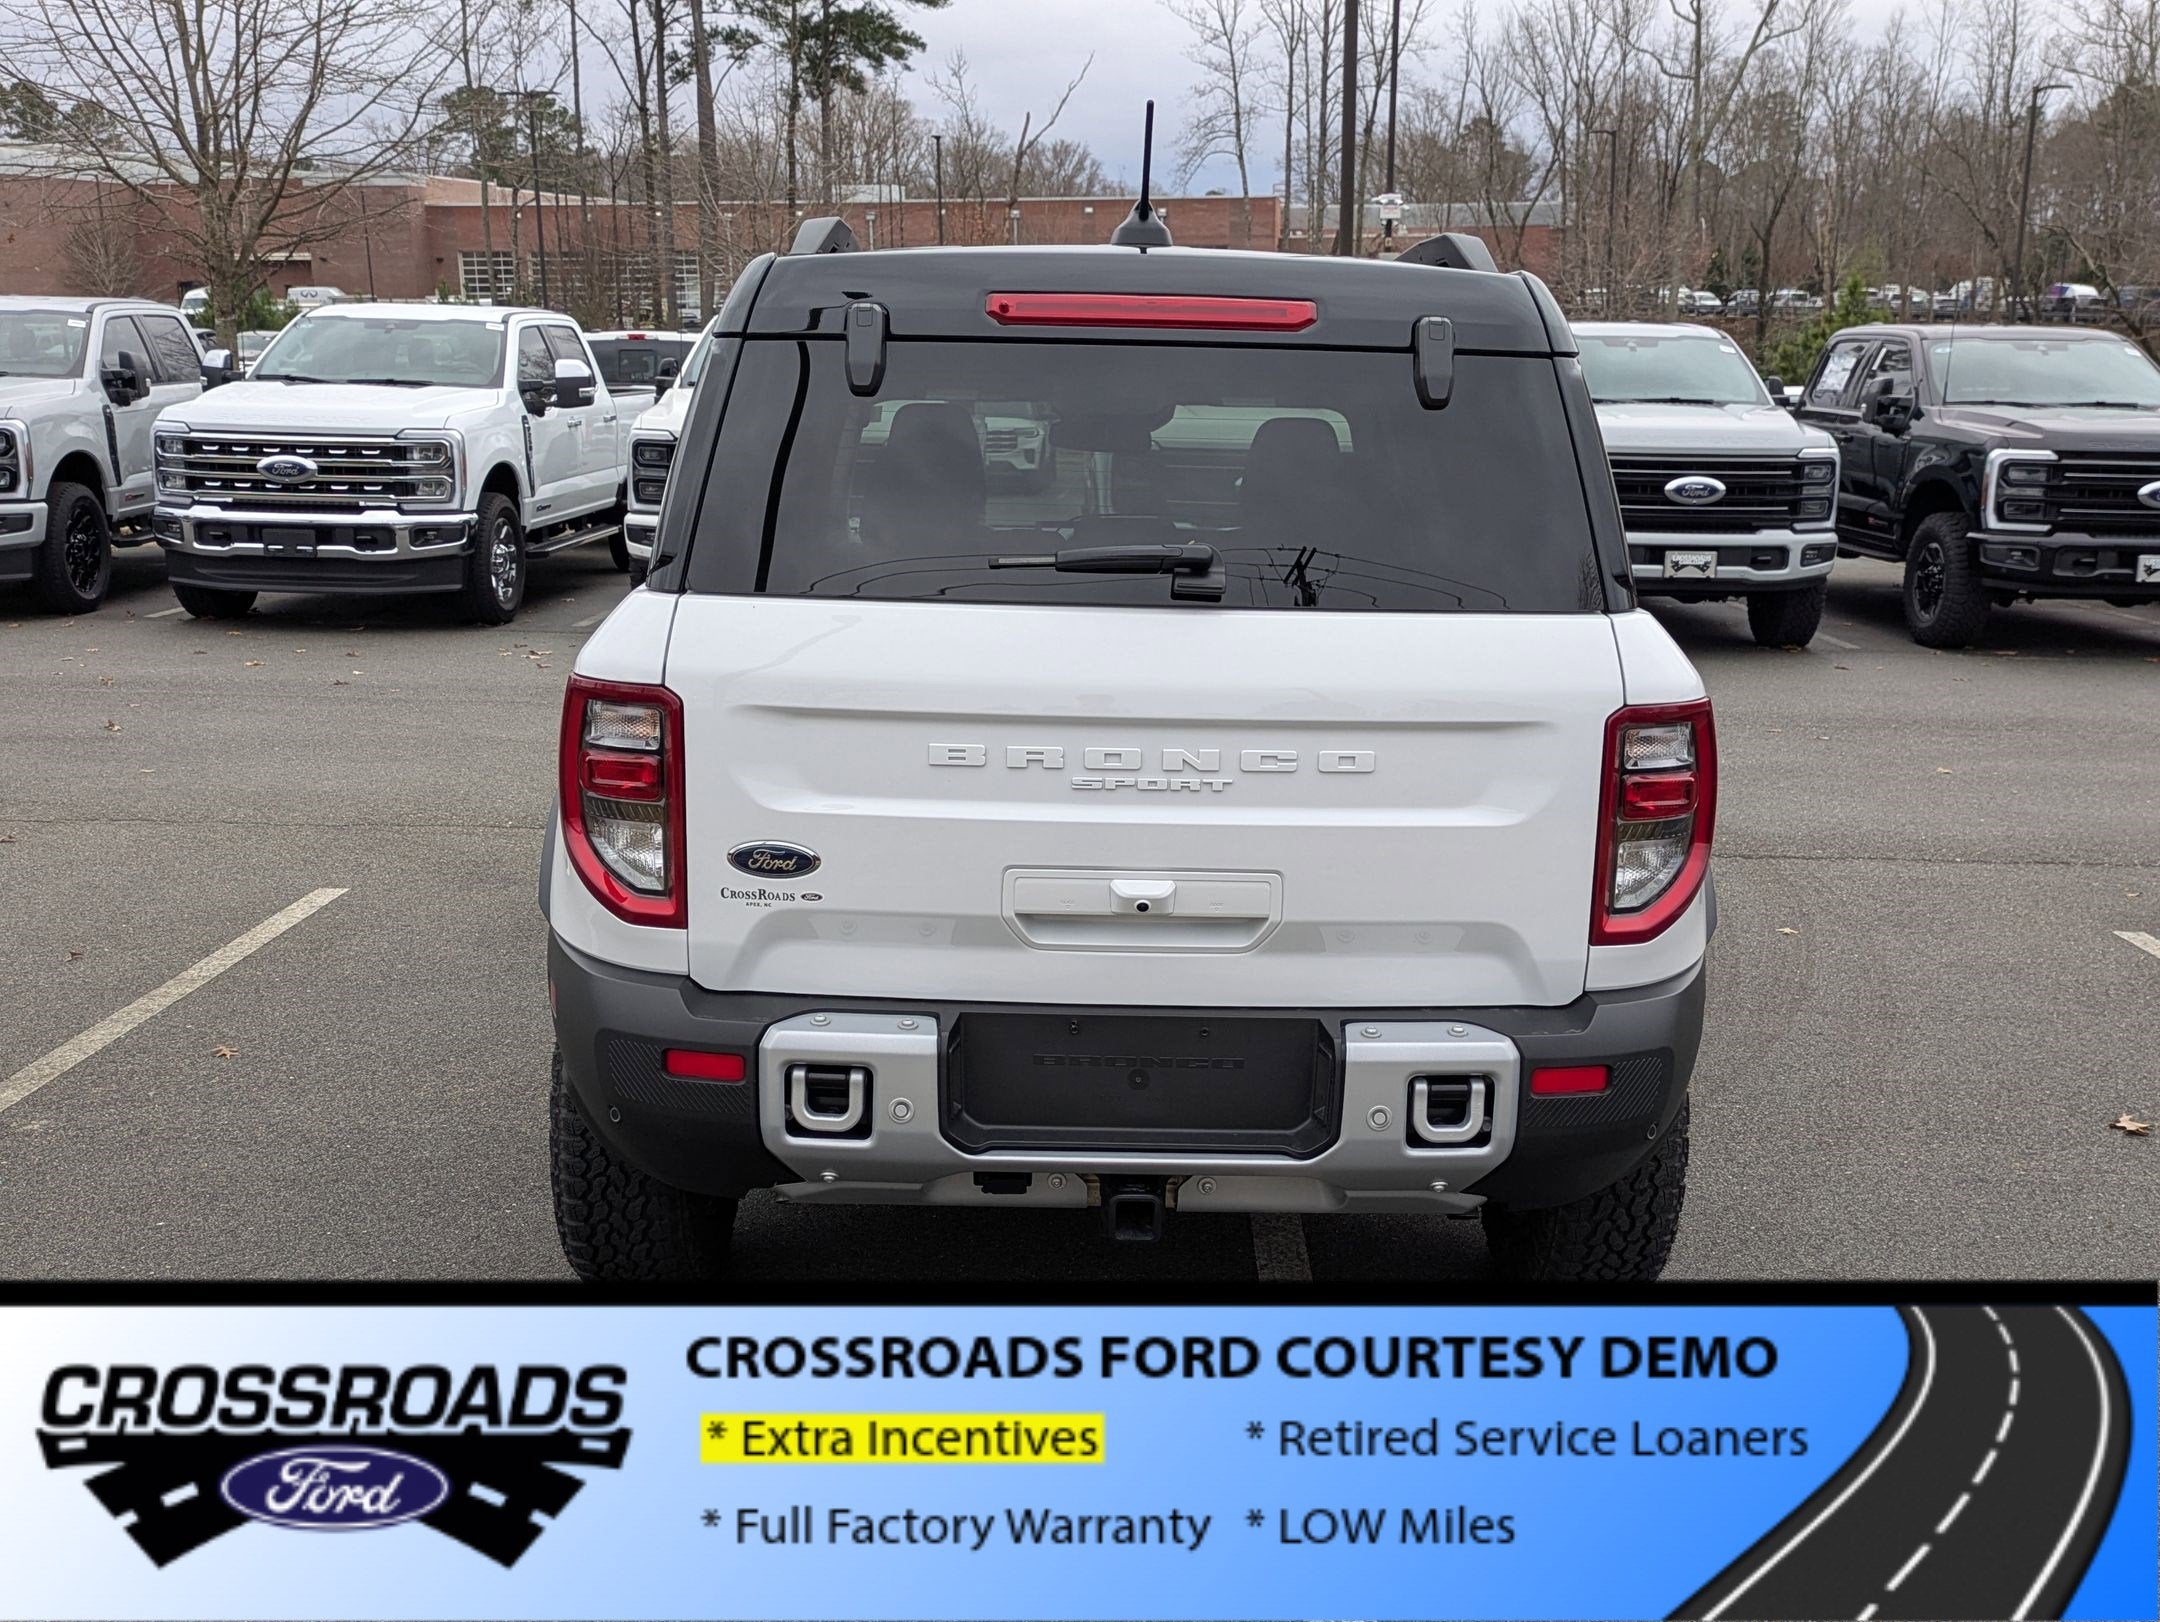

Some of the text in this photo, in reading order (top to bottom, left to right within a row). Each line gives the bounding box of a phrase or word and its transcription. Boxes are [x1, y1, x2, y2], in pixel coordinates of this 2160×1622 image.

[928, 743, 1376, 773] BRONCO
[1071, 776, 1233, 792] SPORT
[747, 848, 798, 871] Ford
[1033, 1054, 1245, 1069] BRONCO
